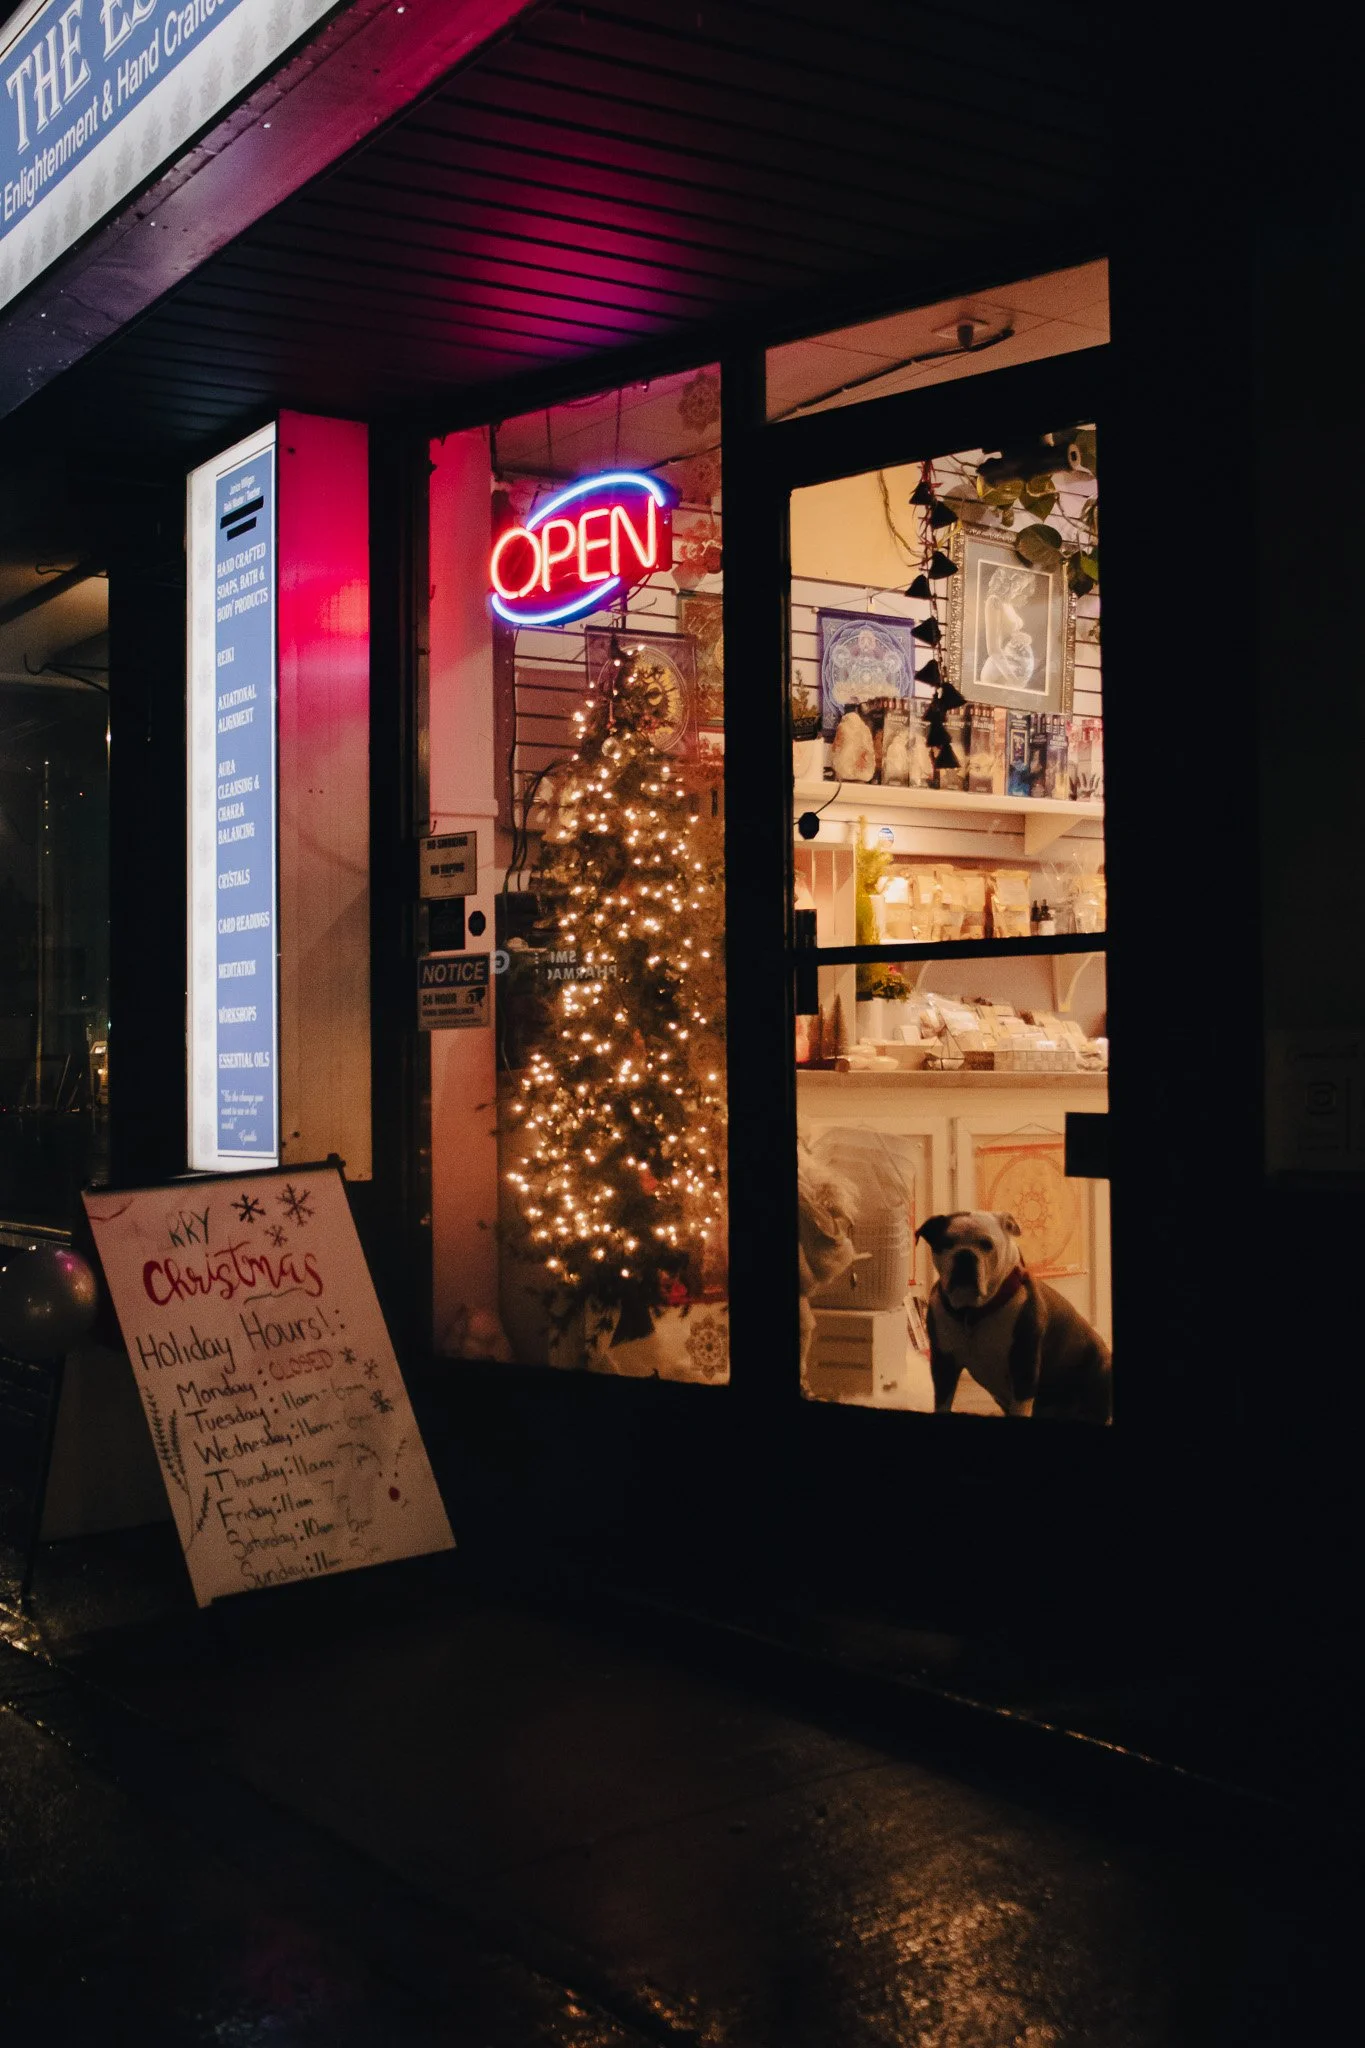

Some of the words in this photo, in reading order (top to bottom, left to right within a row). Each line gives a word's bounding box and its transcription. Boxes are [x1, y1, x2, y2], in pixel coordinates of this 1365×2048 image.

[6, 1, 91, 155] THE
[4, 95, 98, 221] Enlightenment
[101, 78, 113, 122] &
[117, 27, 159, 106] Hand
[217, 553, 235, 579] HAND
[235, 542, 266, 569] CRAFTED
[490, 495, 657, 600] OPEN
[217, 579, 238, 601] SOAPS,
[240, 574, 258, 592] BATH
[259, 573, 266, 585] &
[217, 599, 235, 623] BODY
[236, 587, 268, 614] PRODUCTS
[217, 646, 235, 668] REIKI
[217, 684, 257, 712] AXIATIONAL
[218, 707, 254, 734] ALIGNMENT
[218, 758, 236, 779] AURA
[218, 777, 253, 801] CLEANSING
[254, 774, 260, 789] &
[218, 802, 245, 823] CHAKRA
[218, 822, 255, 845] BALANCING
[218, 869, 251, 890] CRYSTALS
[218, 915, 236, 935] CARD
[236, 911, 270, 932] READINGS
[218, 960, 257, 979] MEDITATION
[421, 960, 486, 985] NOTICE
[218, 1006, 257, 1025] WORKSHOPS
[218, 1051, 253, 1069] ESSENTIAL
[253, 1051, 270, 1068] OILS
[143, 1239, 323, 1305] Christmas
[136, 1325, 236, 1374] Holiday
[269, 1350, 333, 1381] CLOSED
